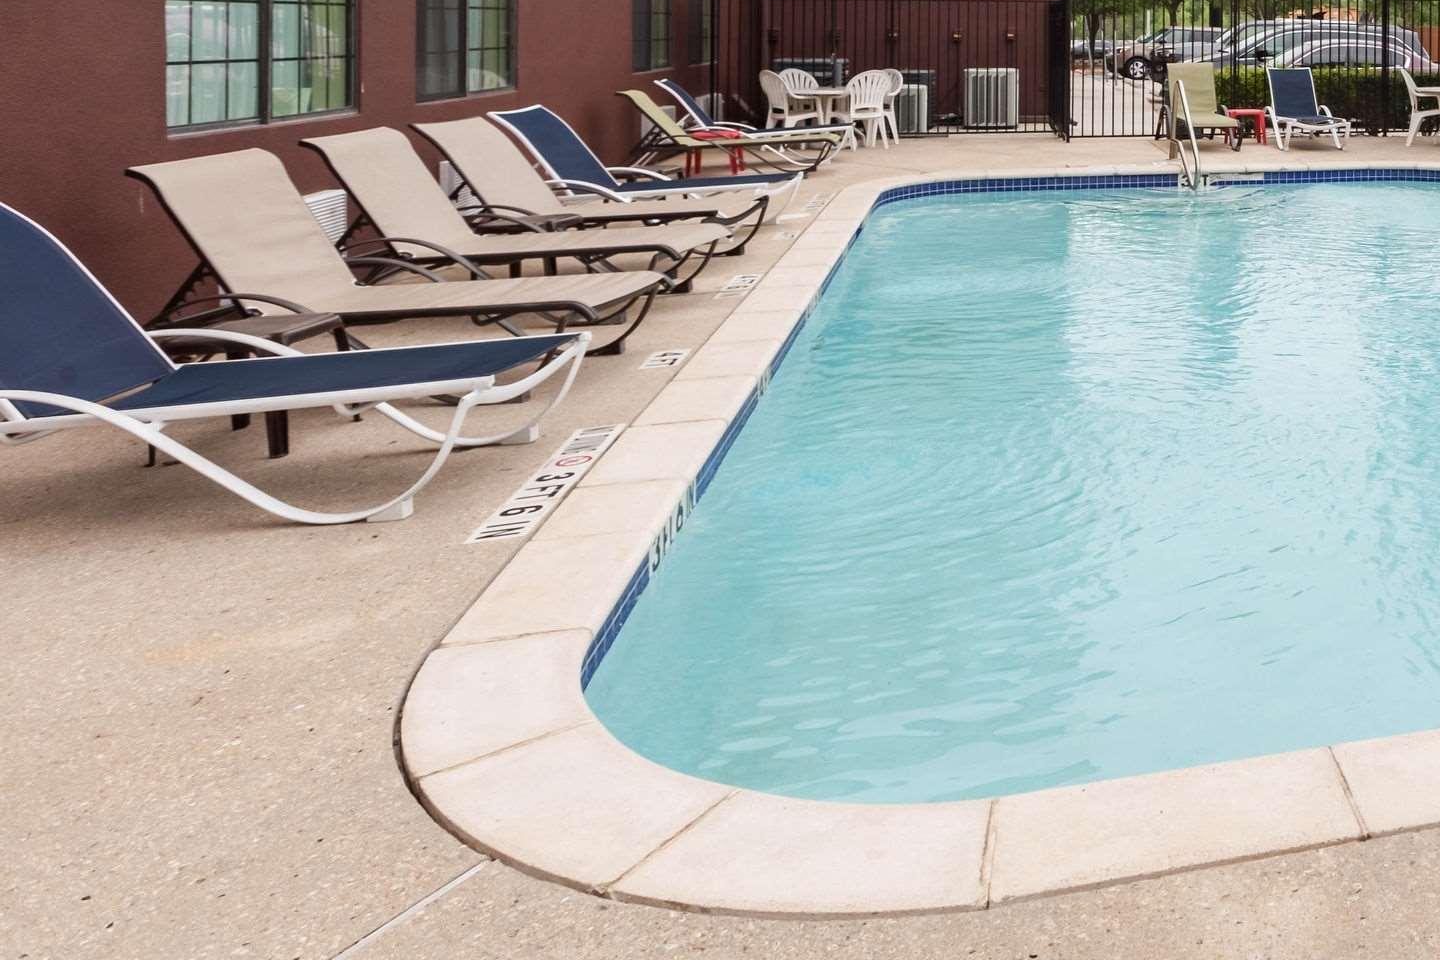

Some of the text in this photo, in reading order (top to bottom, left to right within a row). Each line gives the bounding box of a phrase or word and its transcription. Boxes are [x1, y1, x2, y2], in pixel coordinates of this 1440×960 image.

[474, 471, 576, 540] 3 FT 6 IN
[652, 534, 661, 572] 3
[675, 499, 684, 533] 6
